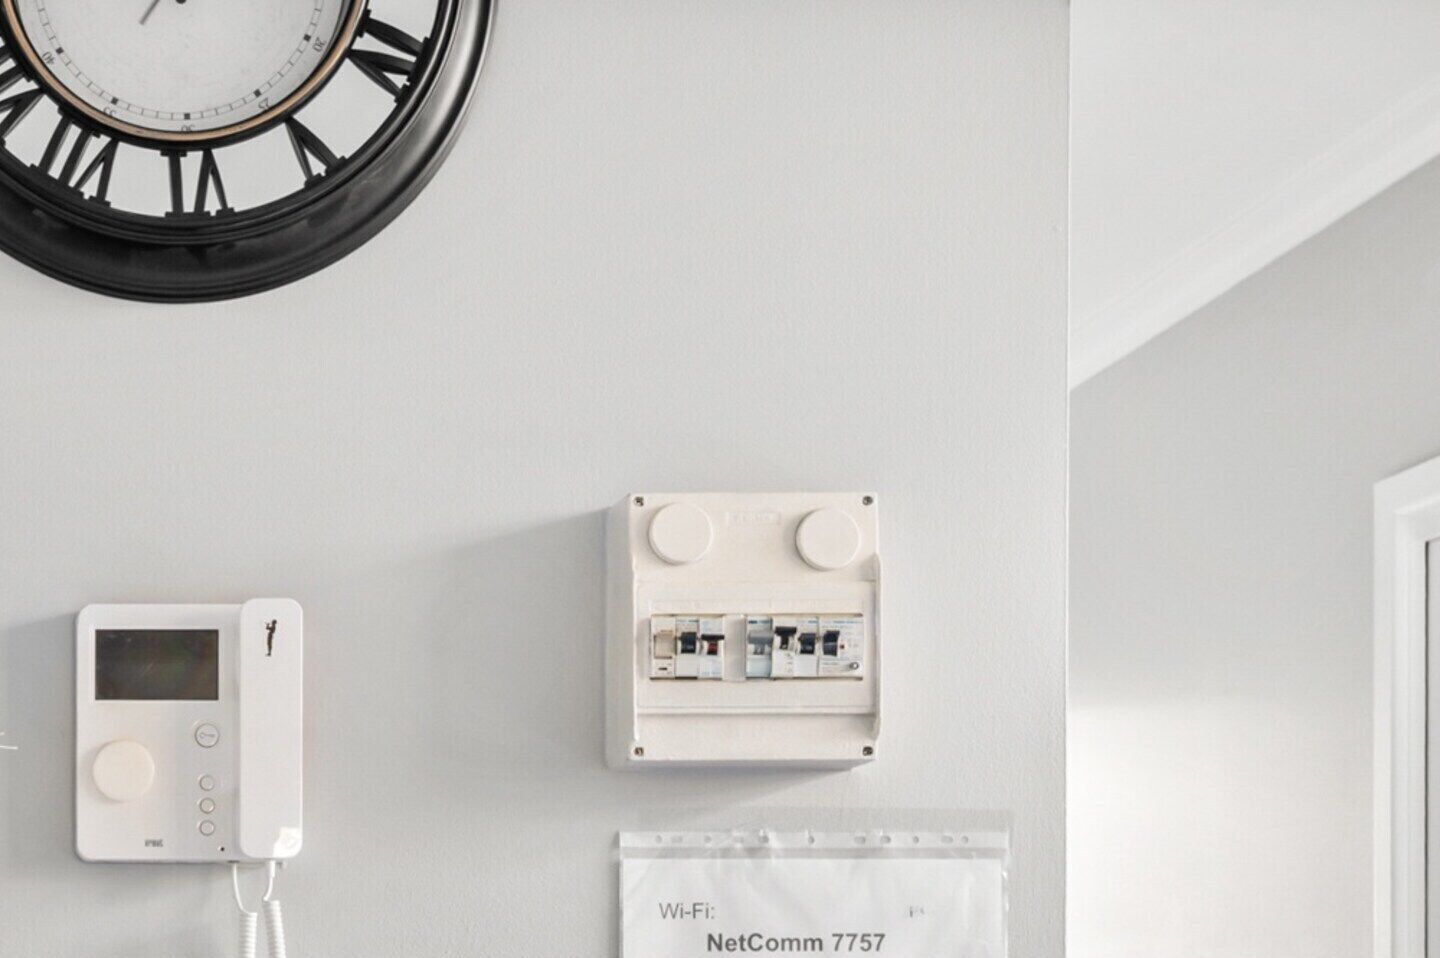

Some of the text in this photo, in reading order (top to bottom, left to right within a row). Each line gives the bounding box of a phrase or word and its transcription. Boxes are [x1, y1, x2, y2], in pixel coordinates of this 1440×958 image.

[659, 902, 715, 920] Wi-Fi:
[707, 933, 886, 952] NetComm 7757
